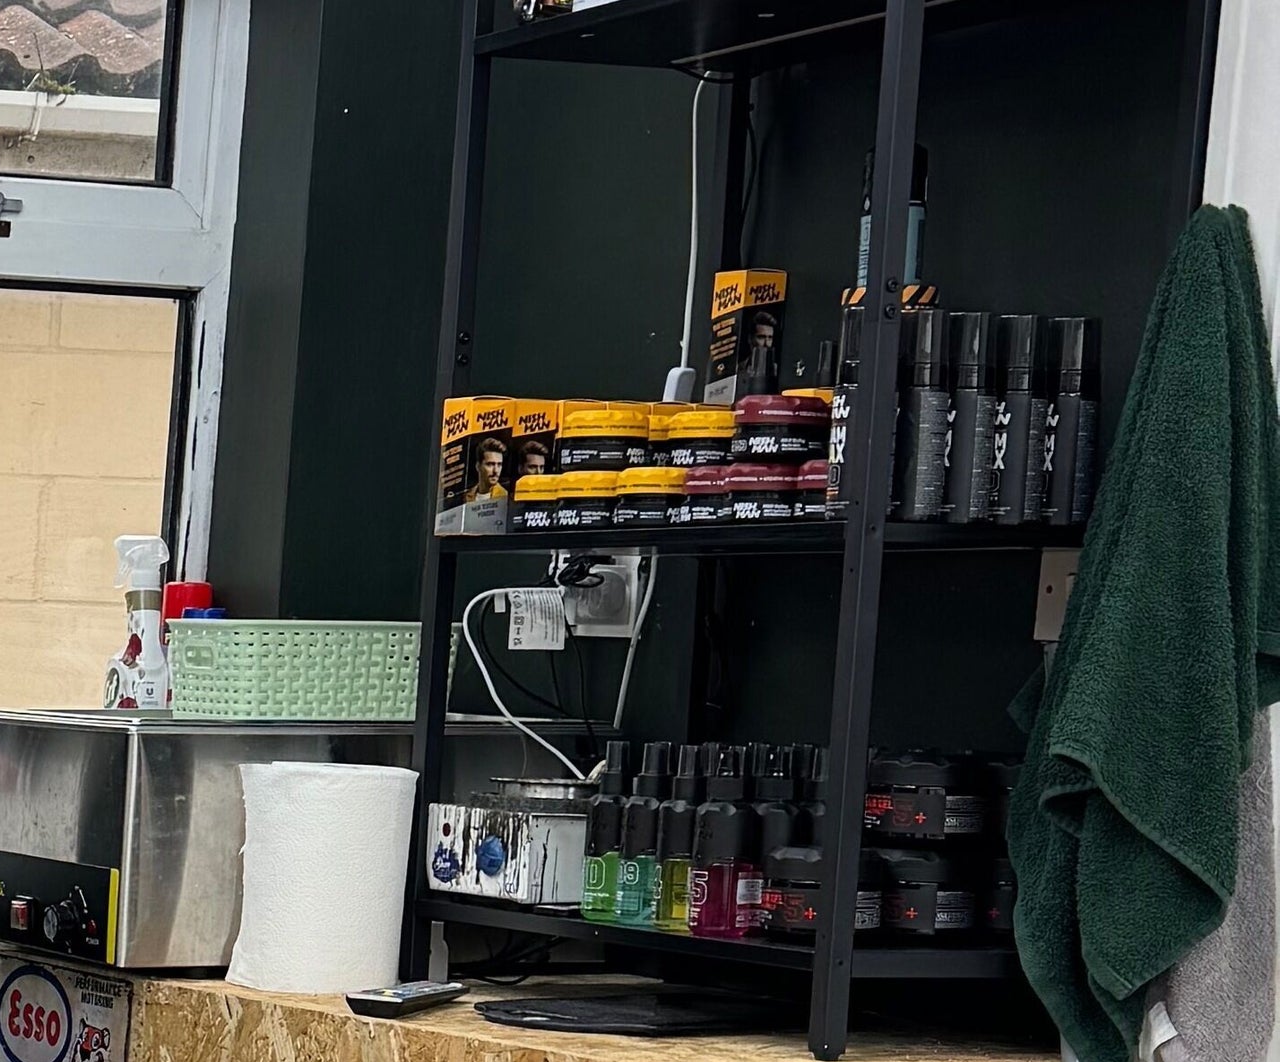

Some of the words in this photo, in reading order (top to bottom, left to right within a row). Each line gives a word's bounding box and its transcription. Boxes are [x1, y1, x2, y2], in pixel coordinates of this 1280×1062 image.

[717, 293, 742, 312] MAN
[754, 291, 781, 304] MAN
[444, 409, 466, 428] NISH
[476, 408, 505, 423] NISH
[518, 411, 547, 426] NISH
[447, 420, 469, 438] MAN
[482, 418, 509, 431] MAN
[524, 420, 551, 433] MAN
